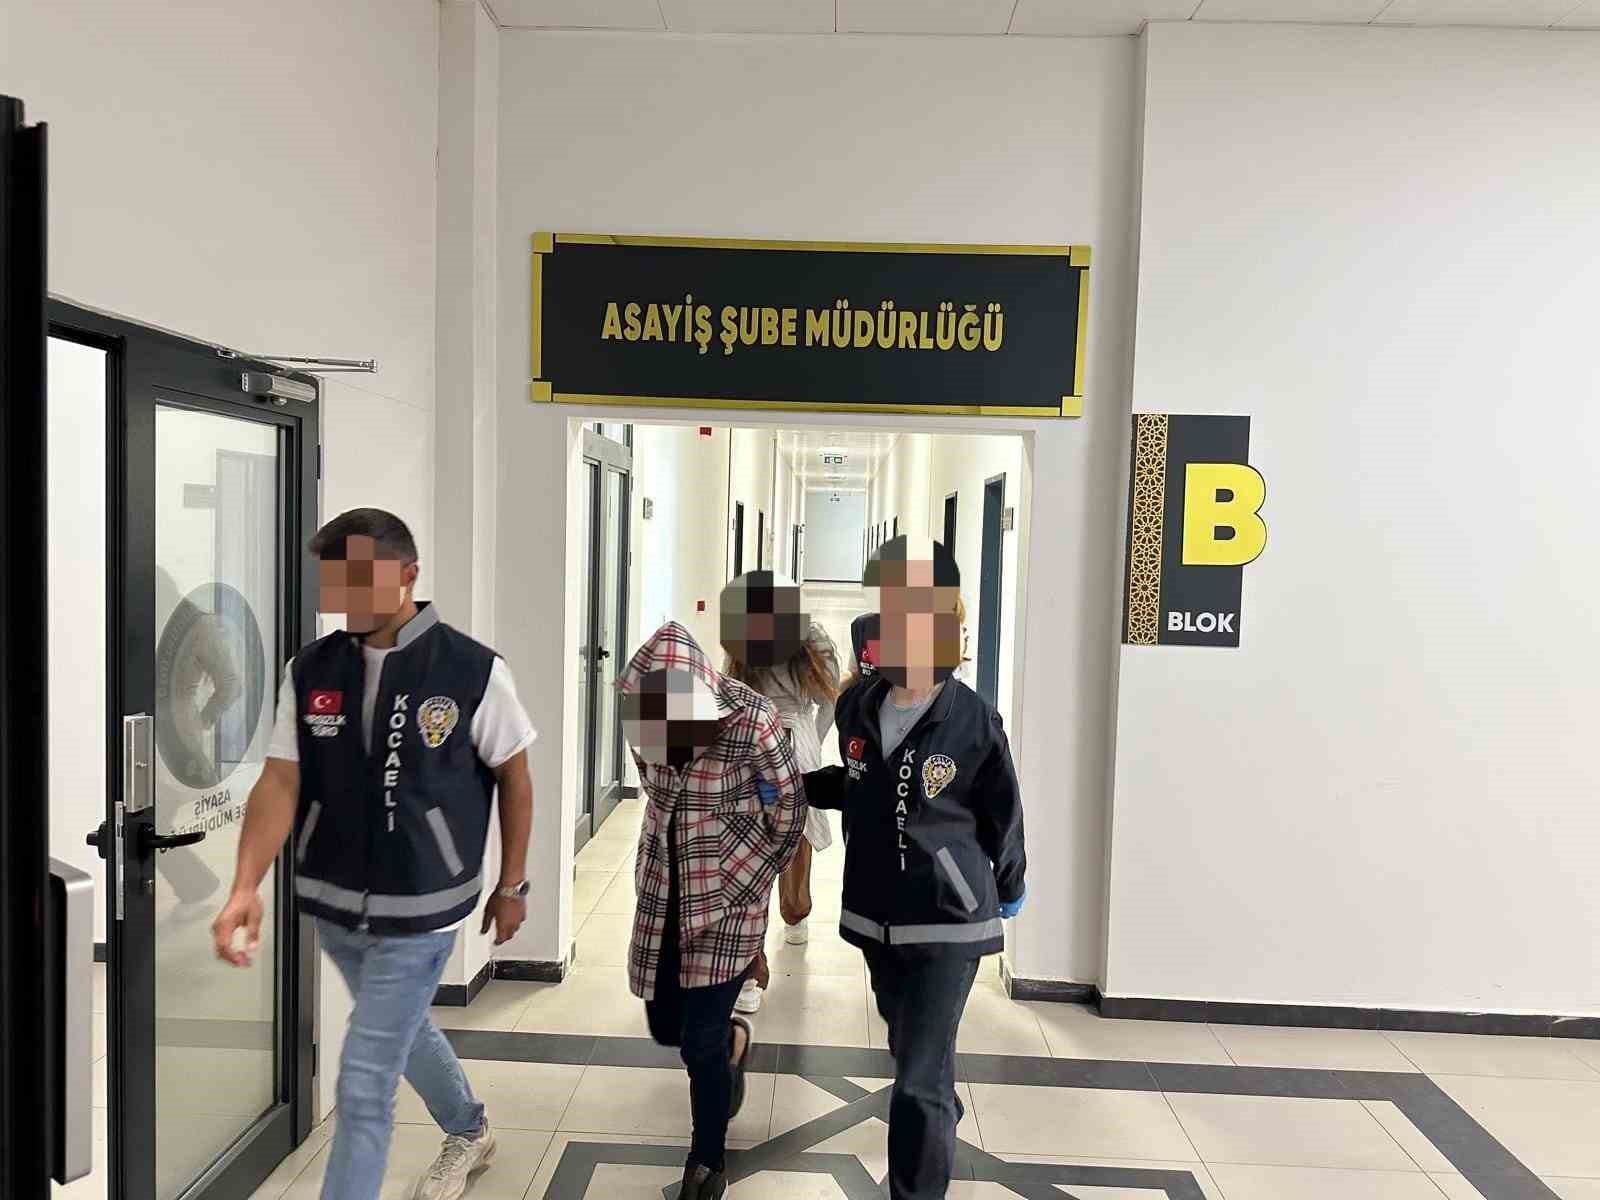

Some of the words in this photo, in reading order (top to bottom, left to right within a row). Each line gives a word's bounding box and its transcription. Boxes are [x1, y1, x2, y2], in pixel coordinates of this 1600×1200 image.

[601, 294, 712, 354] ASAYİŞ
[719, 305, 797, 355] ŞUBE
[804, 298, 1003, 352] MÜDÜRLÜĞÜ
[1181, 463, 1267, 566] B
[1167, 611, 1235, 633] BLOK
[383, 693, 410, 832] KOCAELİ
[895, 747, 916, 871] KOCAELİ
